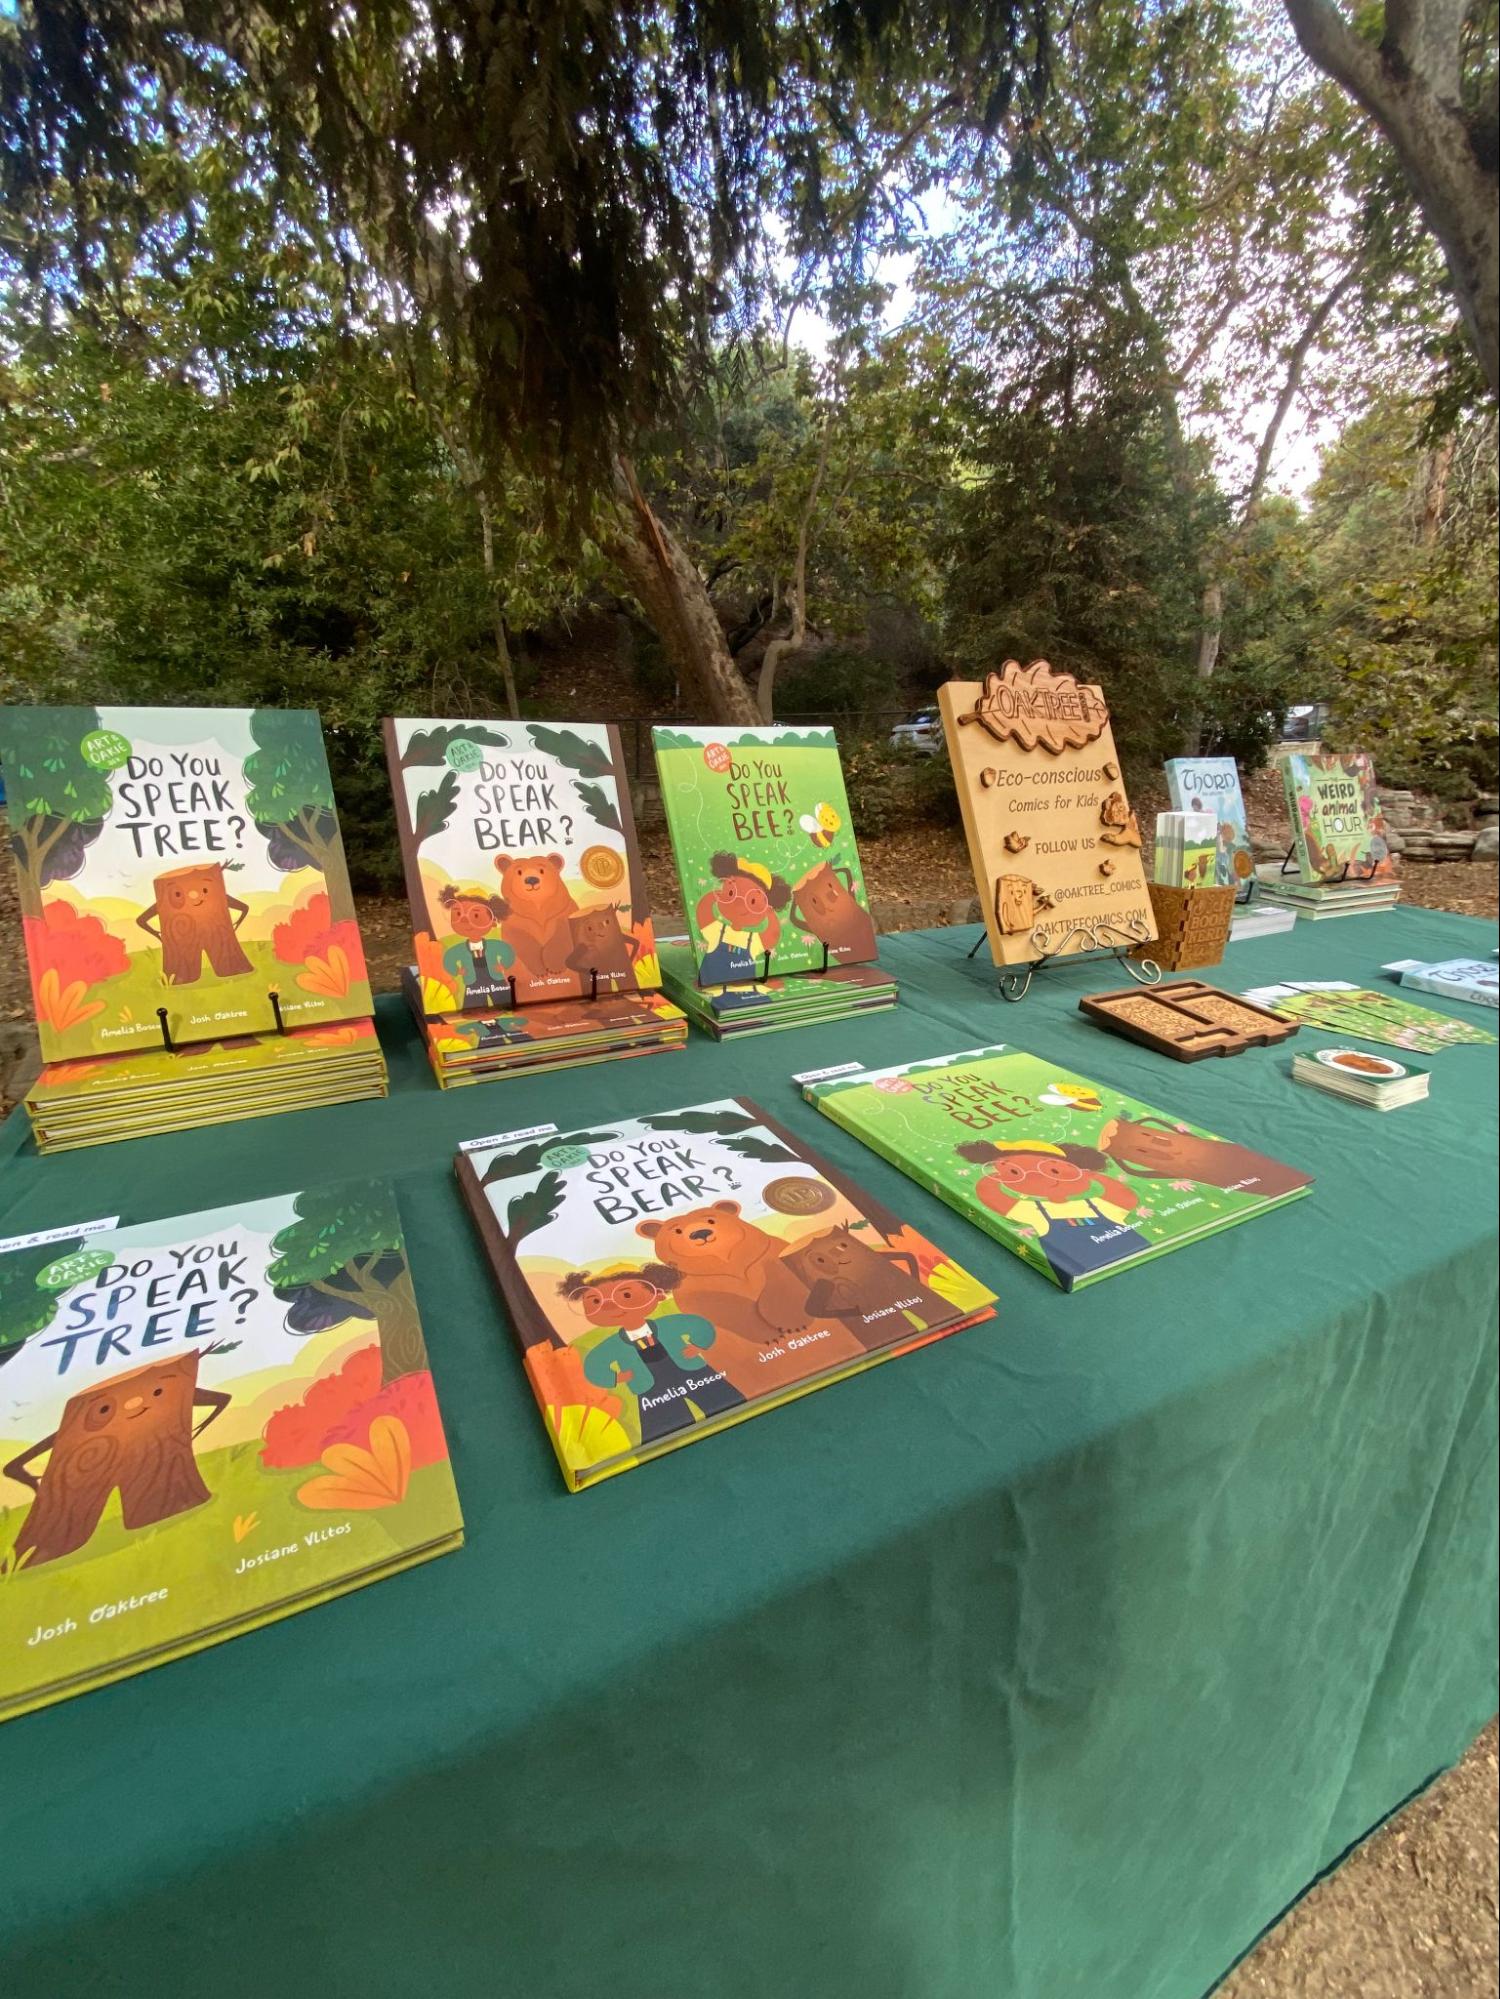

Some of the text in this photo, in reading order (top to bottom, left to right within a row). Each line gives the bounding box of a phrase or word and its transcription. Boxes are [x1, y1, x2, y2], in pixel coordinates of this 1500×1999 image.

[87, 734, 110, 752] ART
[126, 752, 222, 781] DO YOU
[479, 759, 549, 782] DO YOU
[728, 759, 783, 781] DO YOU
[996, 766, 1102, 788] Eco-conscious
[118, 779, 235, 819] SPEAK
[473, 783, 559, 815] SPEAK
[726, 780, 792, 810] SPEAK
[1008, 792, 1100, 813] Comics for Kids
[1317, 783, 1356, 800] WEIRD
[1322, 799, 1358, 817] animal
[114, 815, 246, 858] TREE?
[473, 814, 574, 850] BEAR?
[732, 808, 795, 842] BEE?
[1323, 816, 1363, 834] HOUR
[1035, 837, 1096, 855] FOLLOW US
[1054, 878, 1142, 903] @OAKTREE_COMICS
[466, 984, 490, 996] Amelia
[101, 1022, 162, 1039] Amelia Bosco
[189, 1013, 212, 1025] Josh
[911, 1081, 944, 1095] DO
[937, 1073, 982, 1086] YOU
[922, 1081, 1014, 1112] SPEAK
[949, 1095, 1044, 1130] BEE?
[470, 1137, 499, 1147] Open
[513, 1128, 536, 1138] read
[538, 1125, 553, 1133] me
[586, 1138, 681, 1169] DO YOU
[585, 1147, 706, 1194] SPEAK
[592, 1165, 742, 1225] BEAR?
[46, 1227, 81, 1241] read
[84, 1224, 106, 1233] me
[47, 1255, 107, 1284] OAKIE
[49, 1254, 87, 1275] ART
[96, 1240, 238, 1289] DO YOU
[65, 1256, 248, 1331] SPEAK
[861, 1305, 897, 1325] Josiane
[39, 1287, 259, 1376] TREE?
[757, 1328, 832, 1364] Josh Oaktree
[641, 1369, 727, 1411] Amelia Boscov
[234, 1541, 300, 1575] Josiane
[26, 1586, 169, 1647] Josh Oaktree
